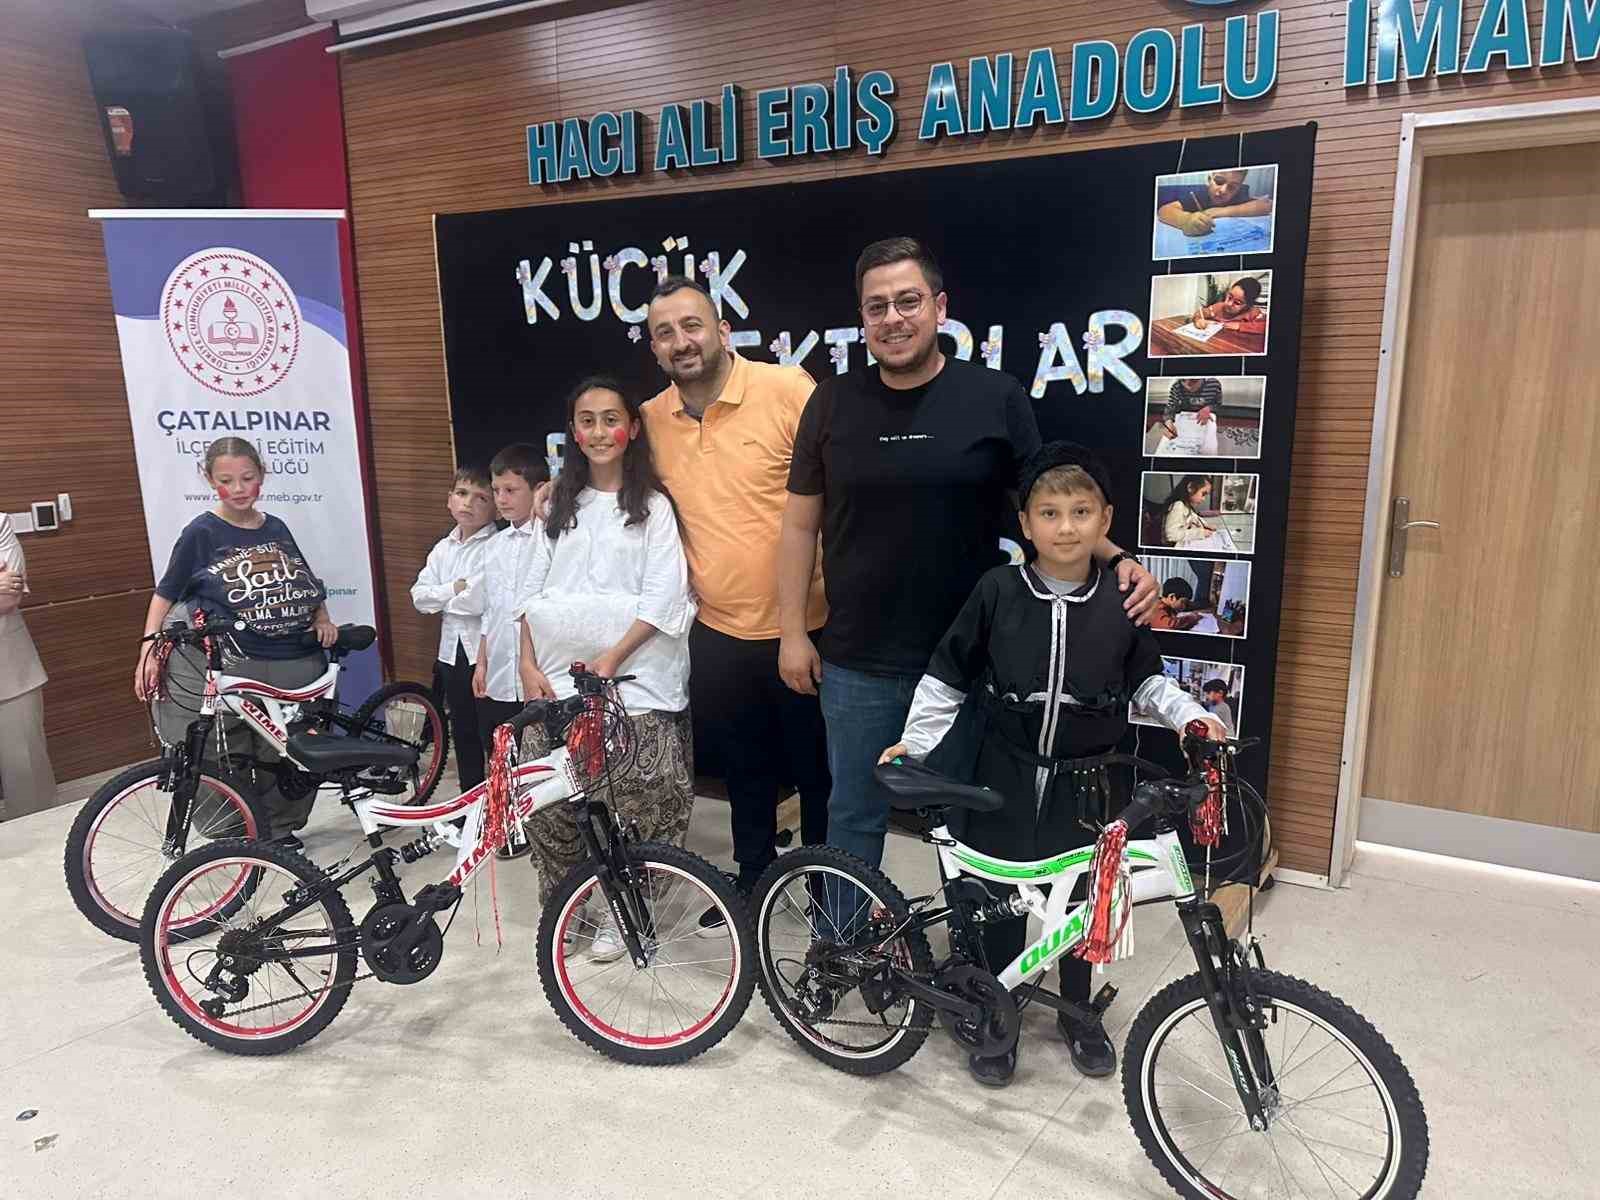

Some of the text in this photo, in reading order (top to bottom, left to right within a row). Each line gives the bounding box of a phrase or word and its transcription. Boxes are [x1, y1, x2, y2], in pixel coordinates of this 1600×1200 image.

[525, 110, 638, 185] HACI
[653, 83, 739, 171] ALİ
[756, 65, 896, 160] ERİŞ
[918, 10, 1281, 140] ANADOLU
[157, 410, 331, 436] ÇATALPINAR
[267, 438, 325, 455] EĞİTİM
[222, 555, 301, 603] Sail
[248, 582, 319, 609] Tailors
